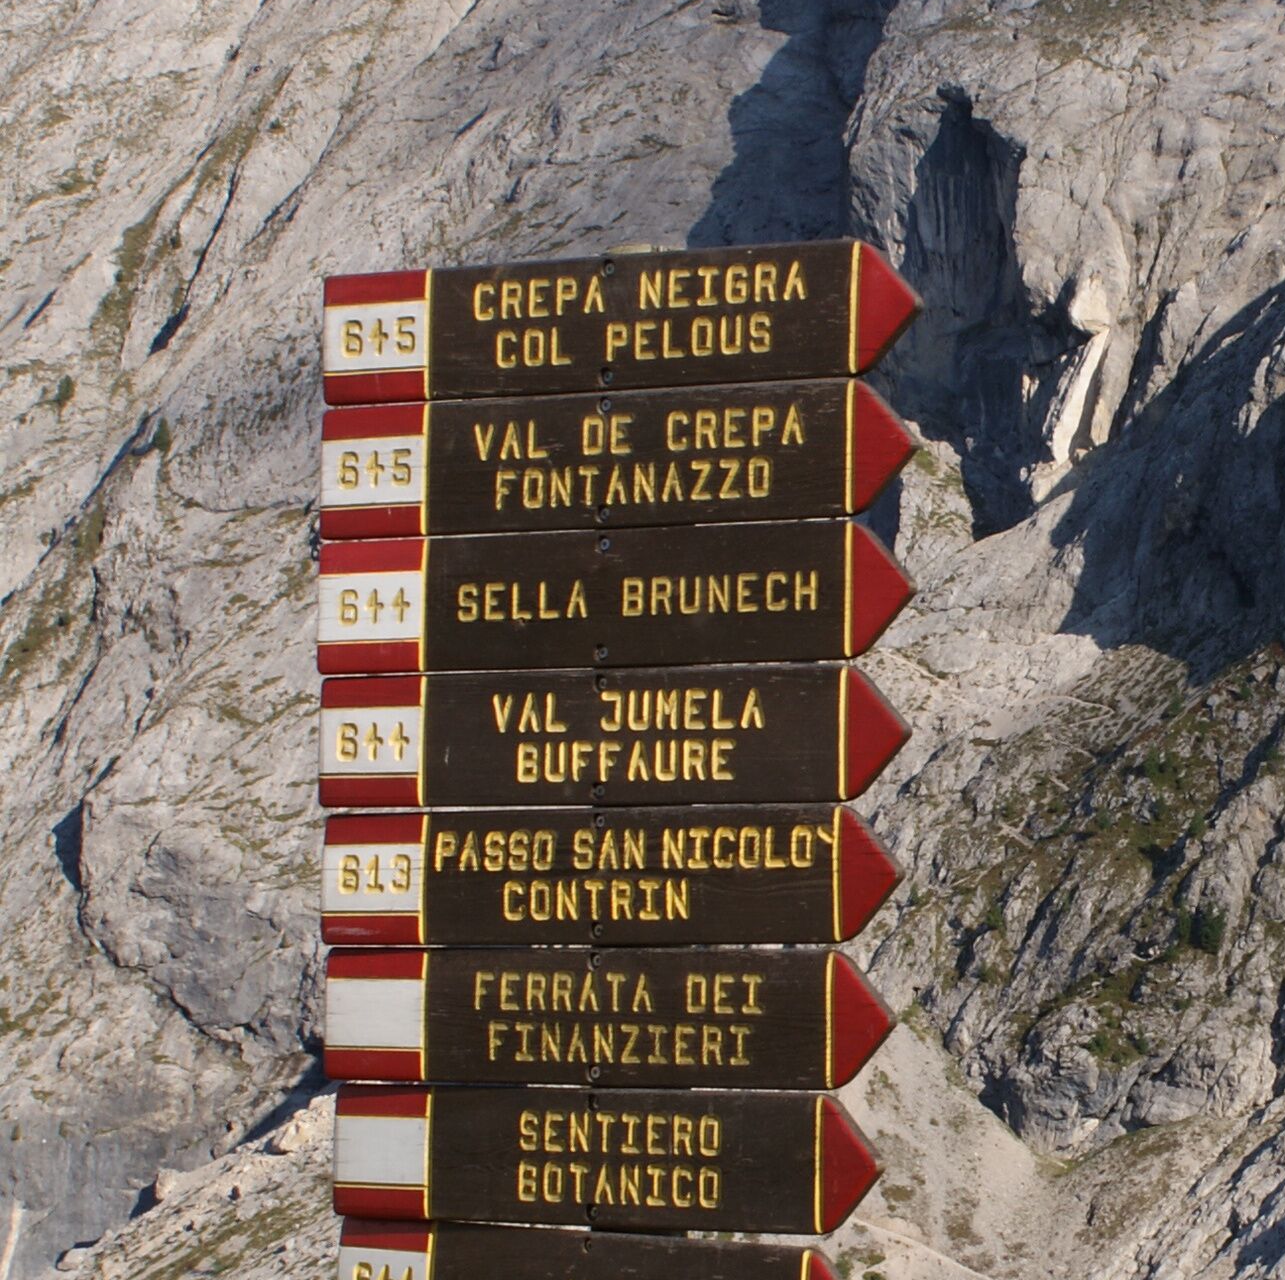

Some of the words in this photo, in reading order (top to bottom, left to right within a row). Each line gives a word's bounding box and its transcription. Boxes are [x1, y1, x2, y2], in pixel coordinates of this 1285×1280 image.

[473, 276, 604, 321] CREPA
[638, 260, 807, 308] NEIGRA
[341, 317, 416, 358] 645
[496, 327, 572, 369] COL
[606, 313, 772, 362] PELOUS
[474, 420, 548, 461] VAL
[582, 416, 632, 456] DE
[667, 403, 803, 451] CREPA
[338, 449, 412, 490] 645
[495, 457, 771, 510] FONTANAZZO
[338, 586, 411, 626] 644
[458, 582, 588, 622] SELLA
[622, 571, 818, 616] BRUNECH
[493, 692, 567, 734] VAL
[601, 688, 765, 731] JUMELA
[336, 721, 410, 762] 644
[517, 740, 735, 782] BUFFAURE
[435, 830, 554, 871] PASSO
[573, 828, 646, 869] SAN
[338, 853, 412, 896] 613
[503, 879, 689, 921] CONTRIN
[474, 972, 653, 1013] FERRATA
[686, 973, 763, 1015] DEI
[488, 1023, 751, 1066] FINANZIERI
[519, 1111, 721, 1157] SENTIERO
[518, 1164, 719, 1208] BOTANICO
